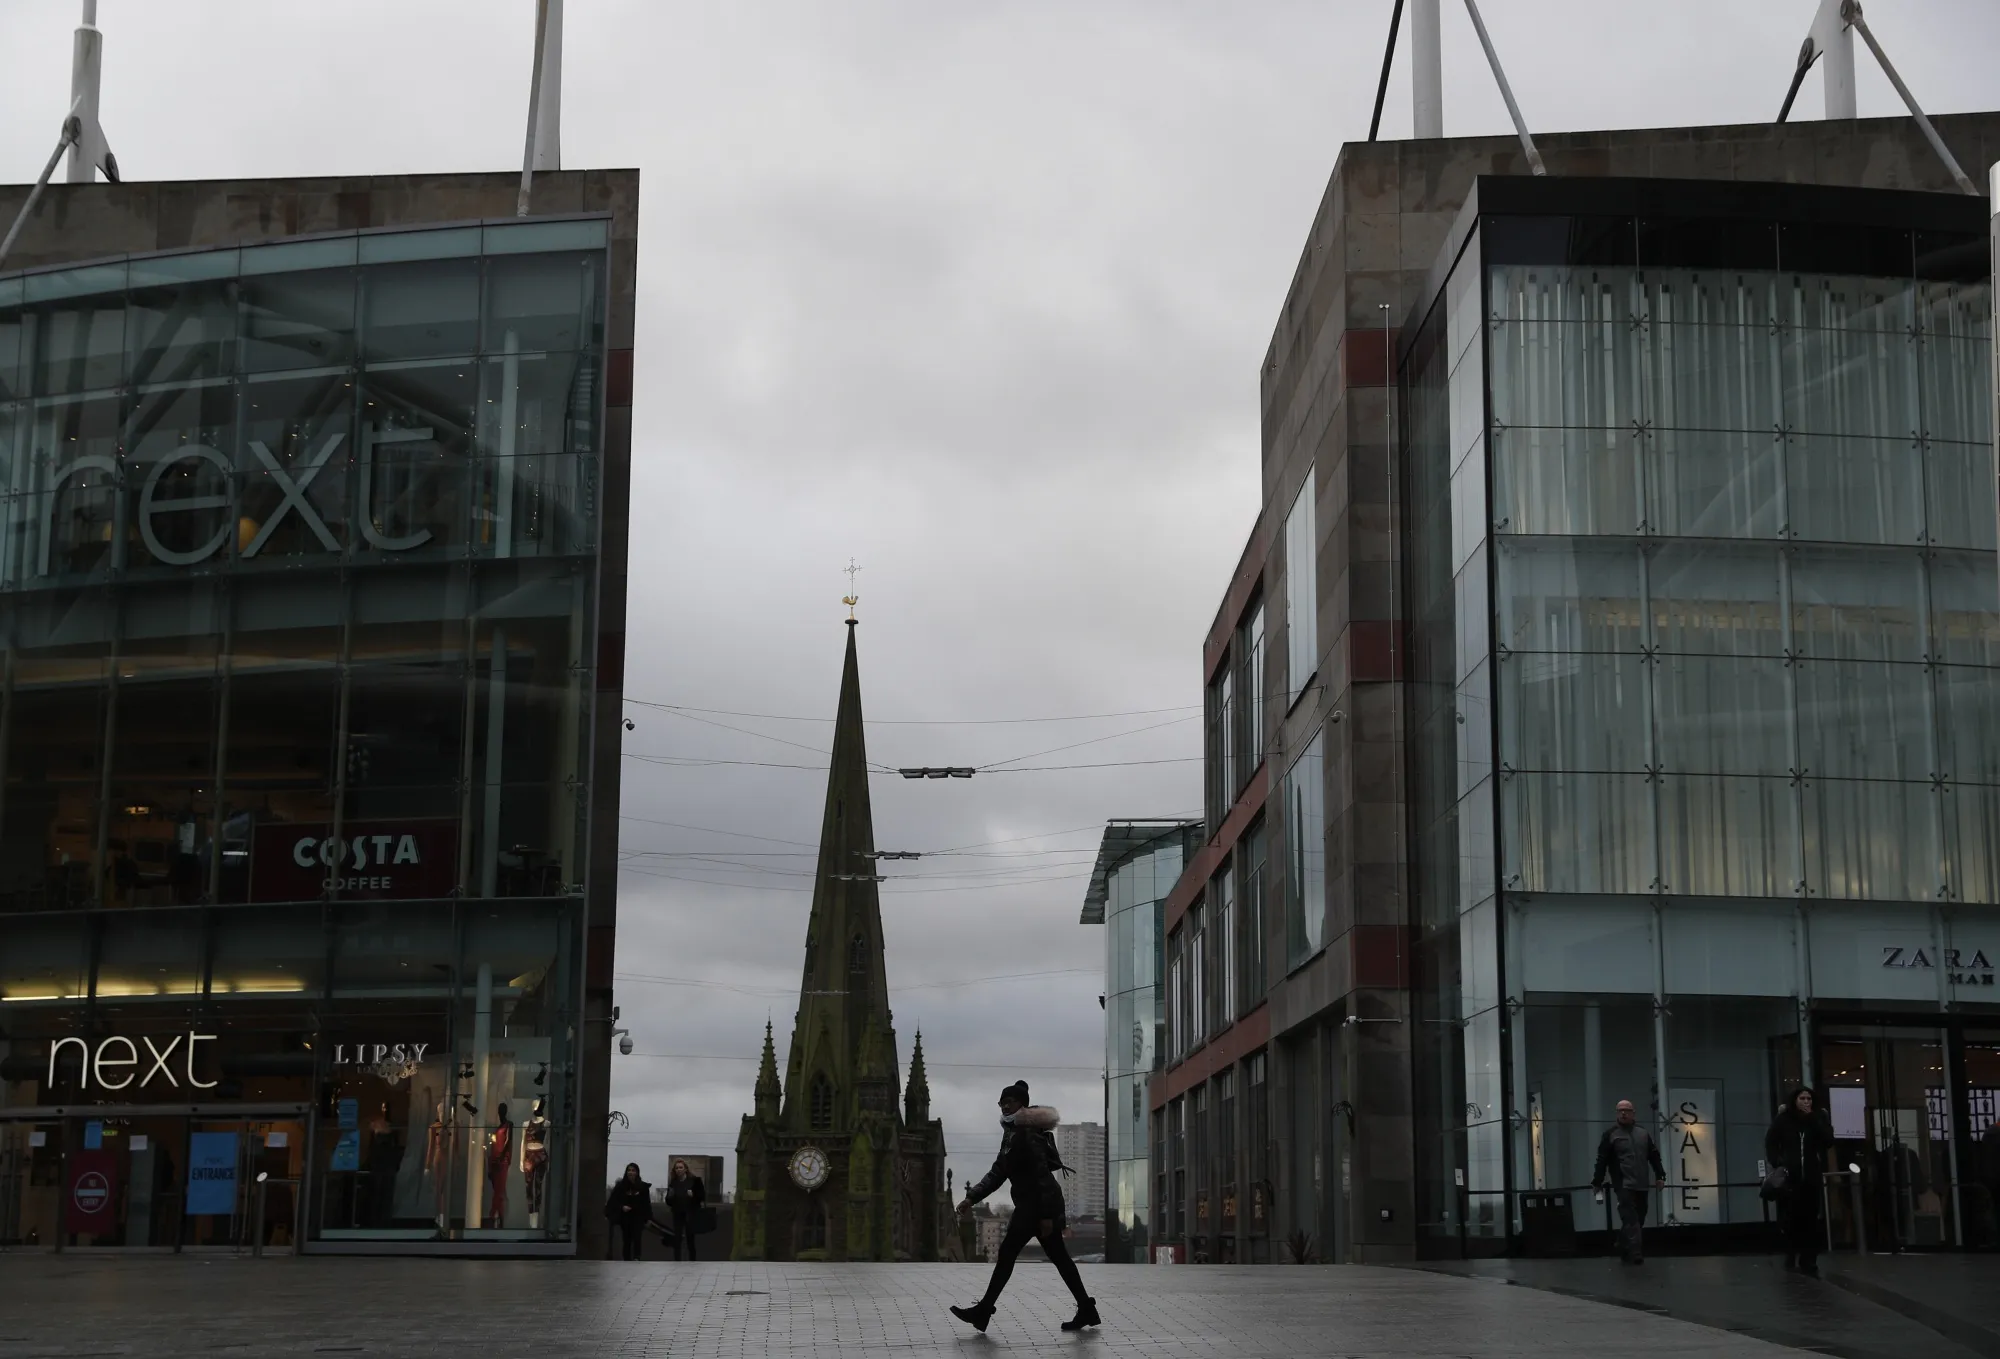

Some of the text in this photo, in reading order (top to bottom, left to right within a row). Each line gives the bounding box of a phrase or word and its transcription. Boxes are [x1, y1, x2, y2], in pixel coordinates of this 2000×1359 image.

[37, 420, 435, 576] next
[293, 834, 420, 871] COSTA
[1883, 947, 1994, 969] ZARA
[1948, 973, 1995, 985] MAN
[48, 1030, 218, 1090] next
[333, 1043, 429, 1063] LIPSY
[1680, 1102, 1701, 1210] SALE
[192, 1167, 235, 1181] ENTRANCE
